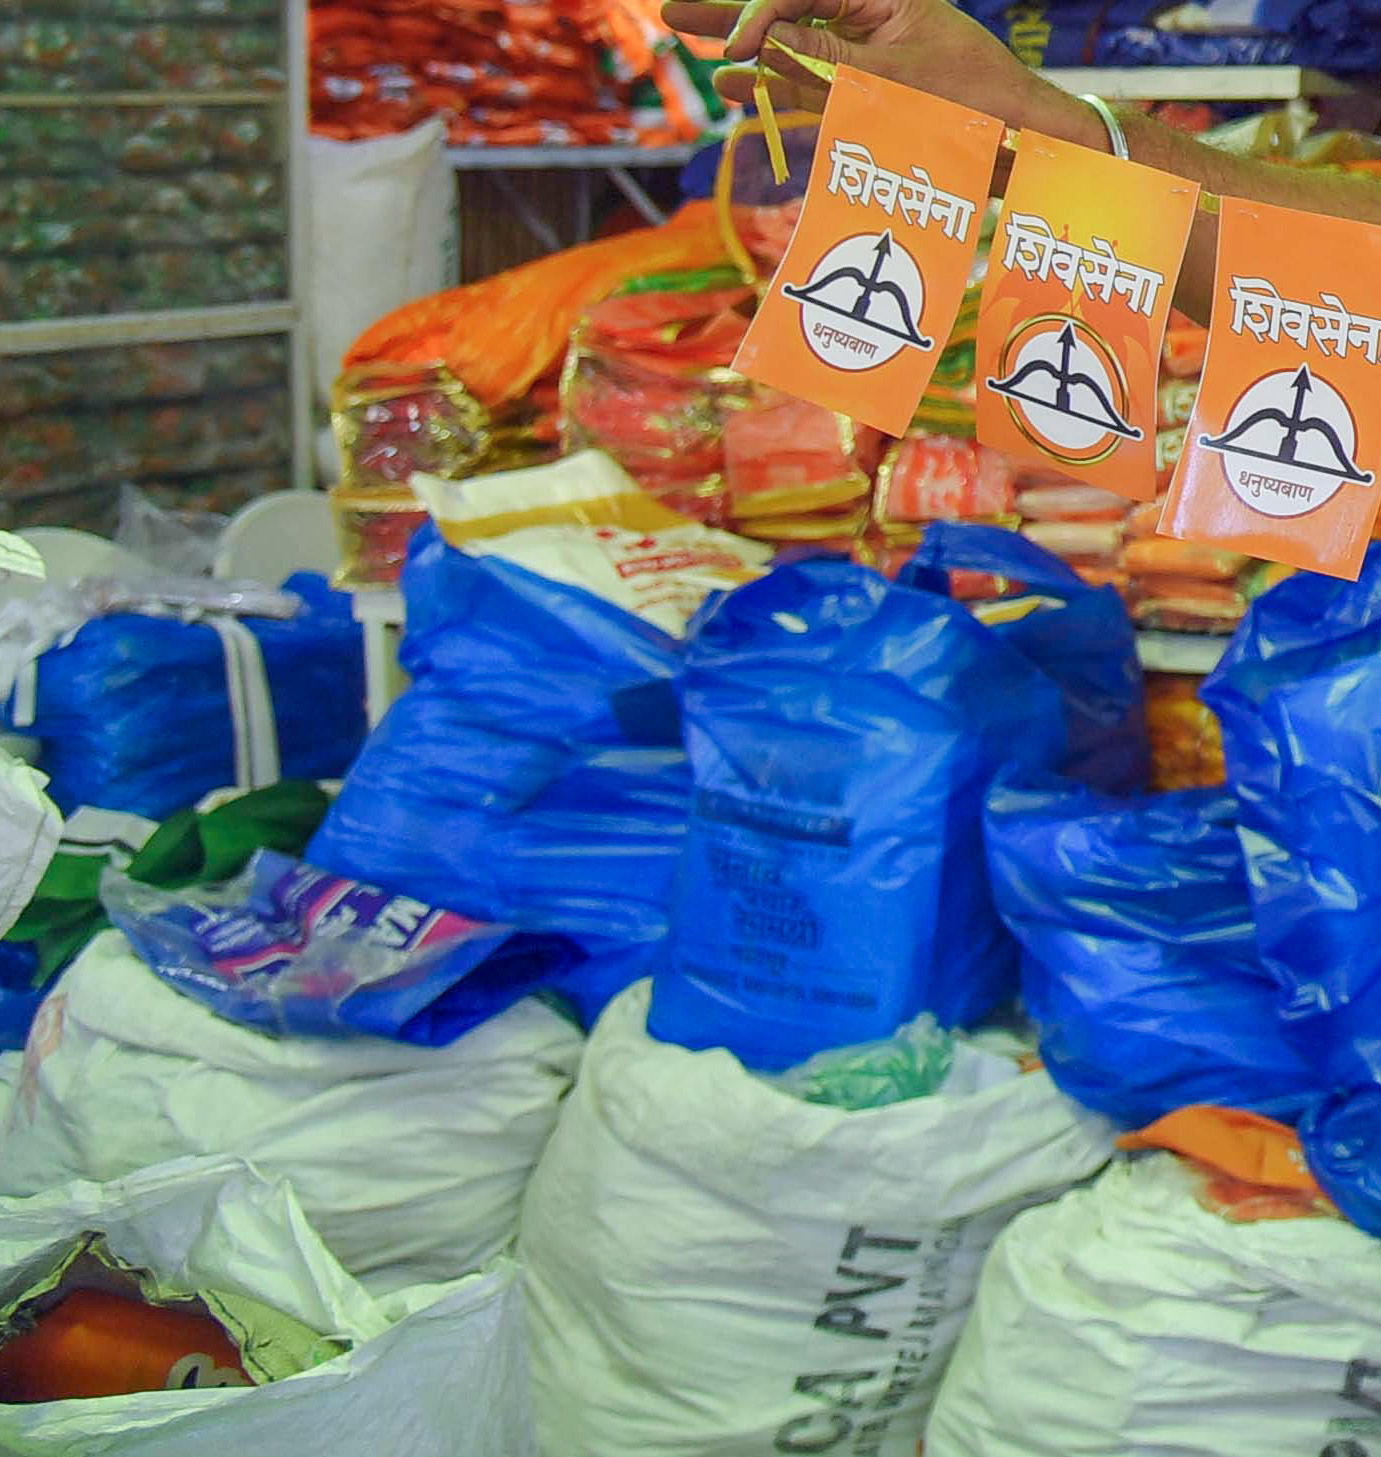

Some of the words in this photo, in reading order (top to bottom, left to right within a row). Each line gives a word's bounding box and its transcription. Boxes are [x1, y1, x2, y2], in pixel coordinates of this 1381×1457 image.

[828, 140, 976, 244] शिवसेना
[1002, 213, 1164, 319] शिवसेना
[812, 321, 879, 360] धनुष्यबाण
[1238, 469, 1314, 504] धनुष्यबाण
[814, 1226, 923, 1341] PVT
